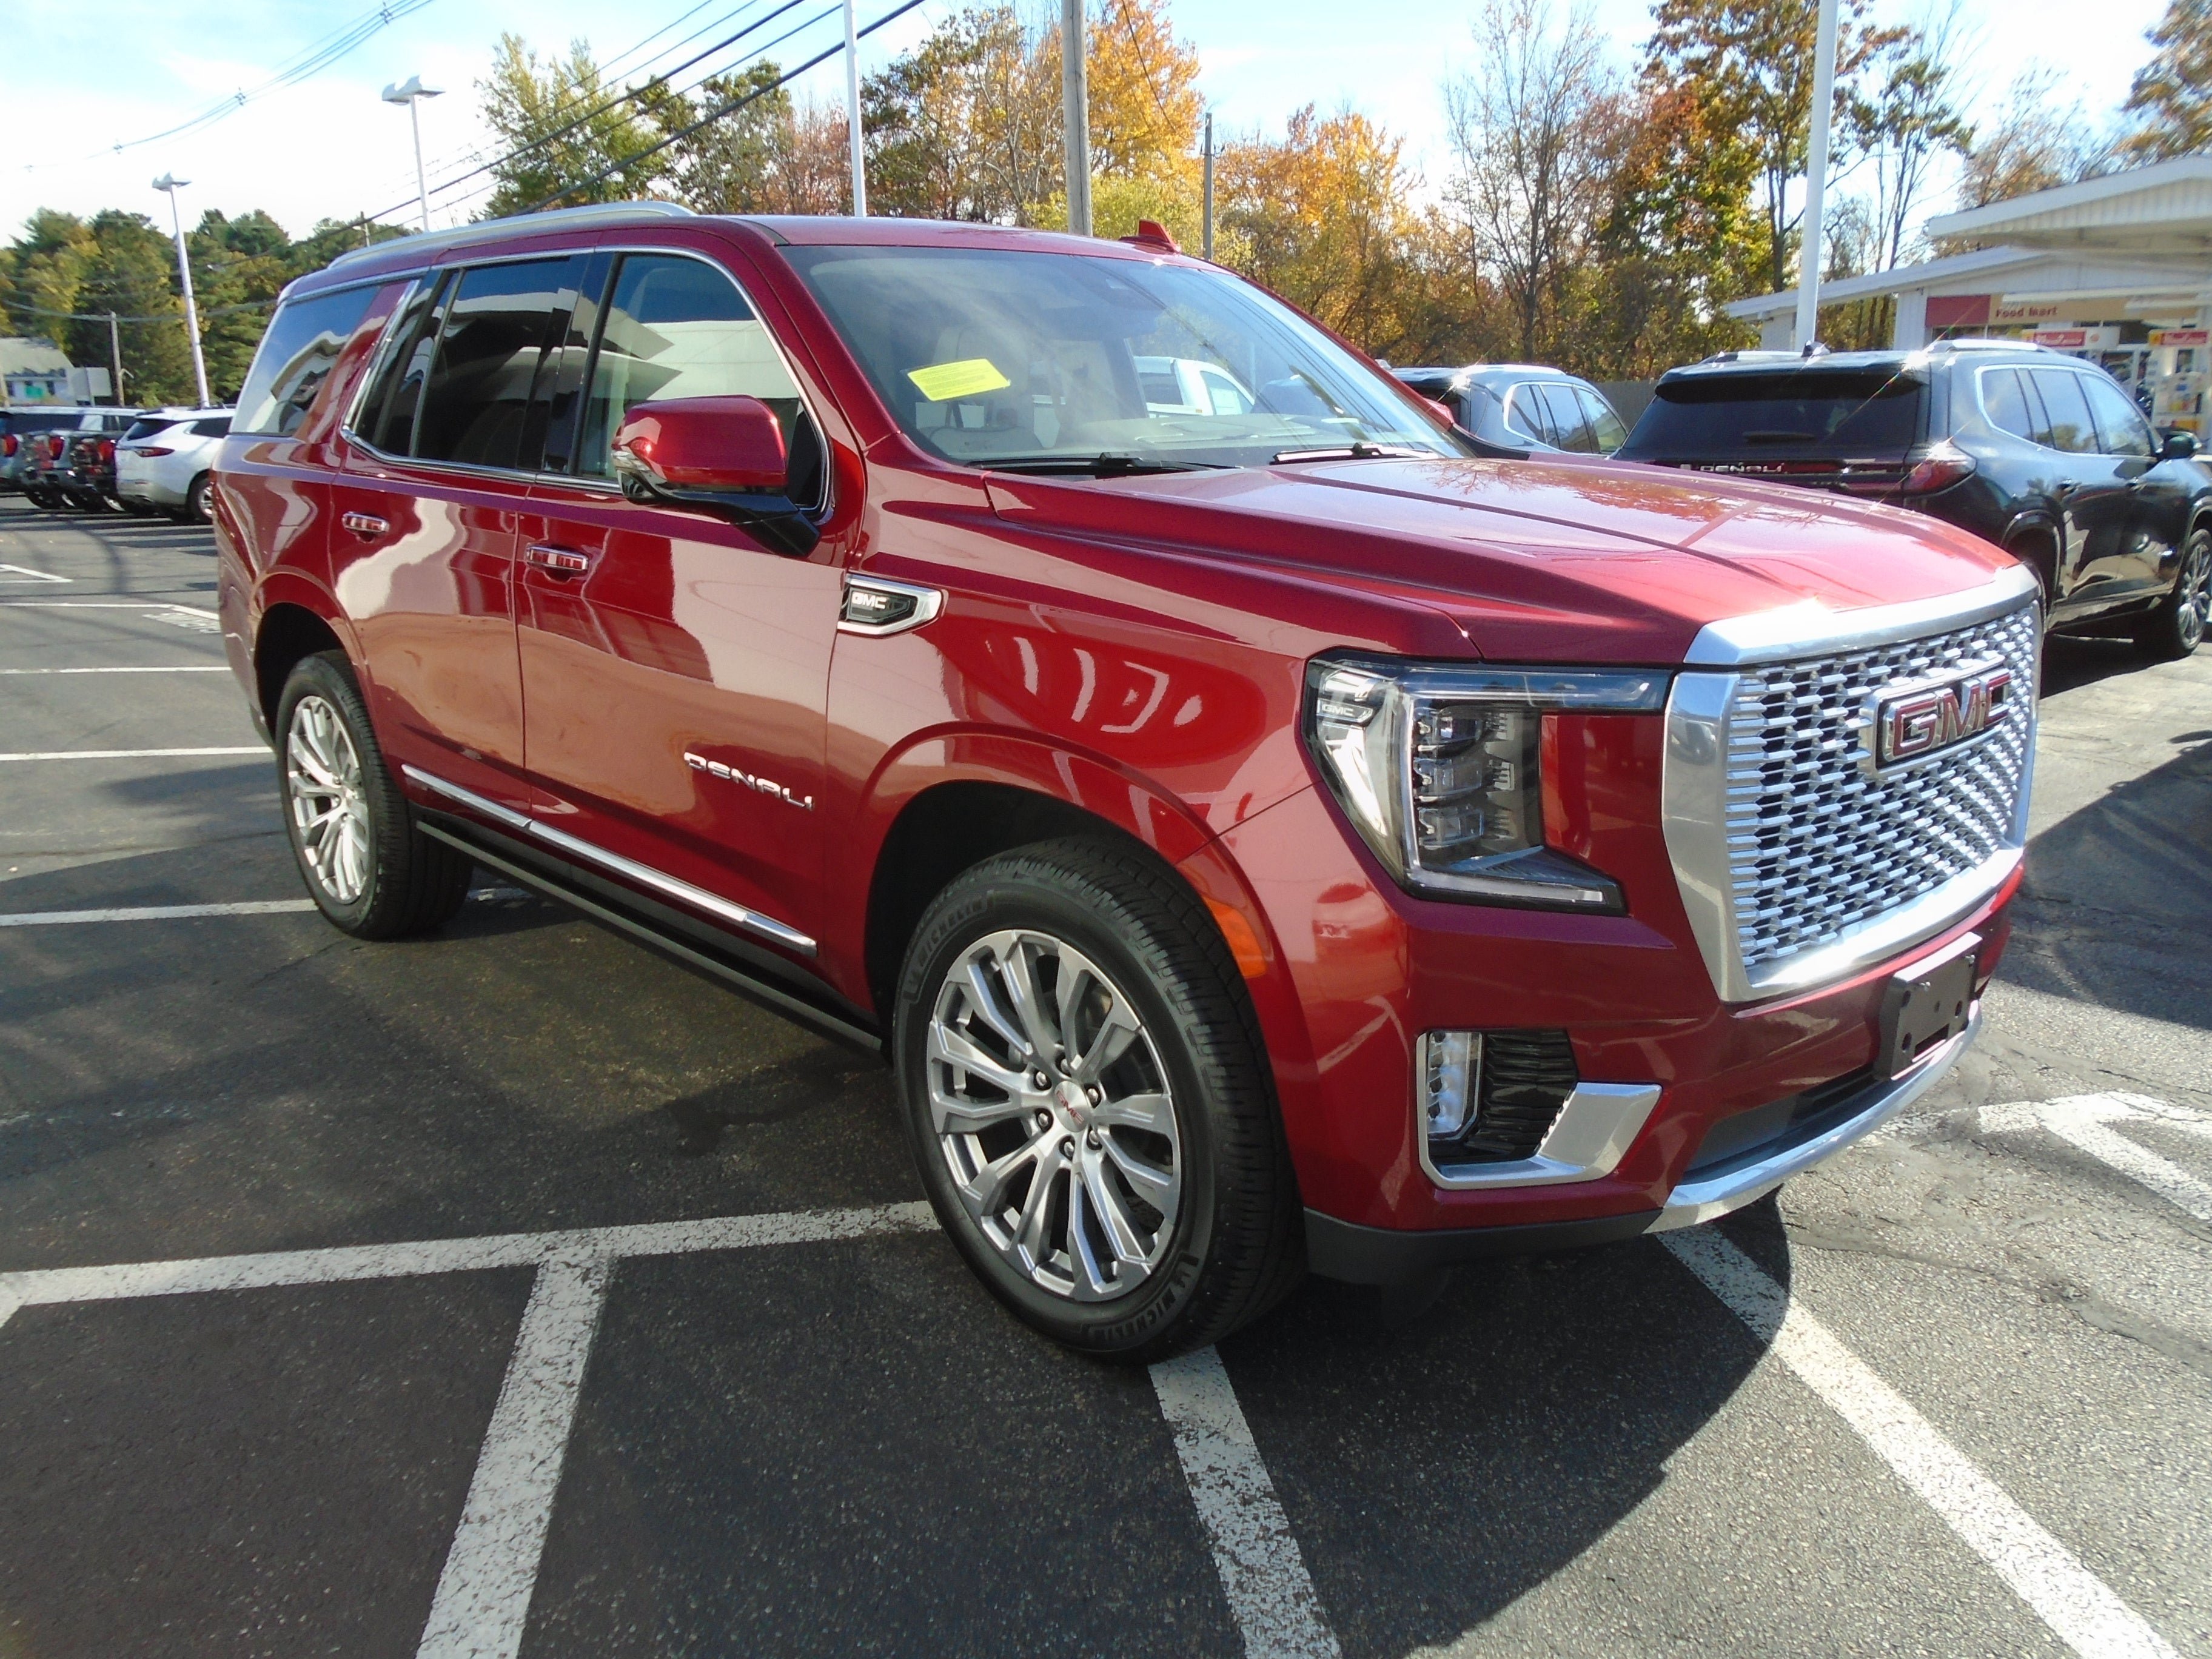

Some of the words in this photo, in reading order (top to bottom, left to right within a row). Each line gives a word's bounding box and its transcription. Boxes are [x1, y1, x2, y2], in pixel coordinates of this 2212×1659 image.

[1996, 307, 2025, 318] Food
[2029, 306, 2058, 317] Mart
[1700, 462, 1785, 474] DENALI
[851, 591, 888, 609] GMC
[1322, 703, 1354, 717] GMC
[1883, 668, 2012, 762] GMC
[683, 751, 814, 811] DENALI
[917, 899, 983, 968] MICHELIN
[1056, 1090, 1084, 1125] GMC
[1093, 1286, 1176, 1339] MICHELIN
